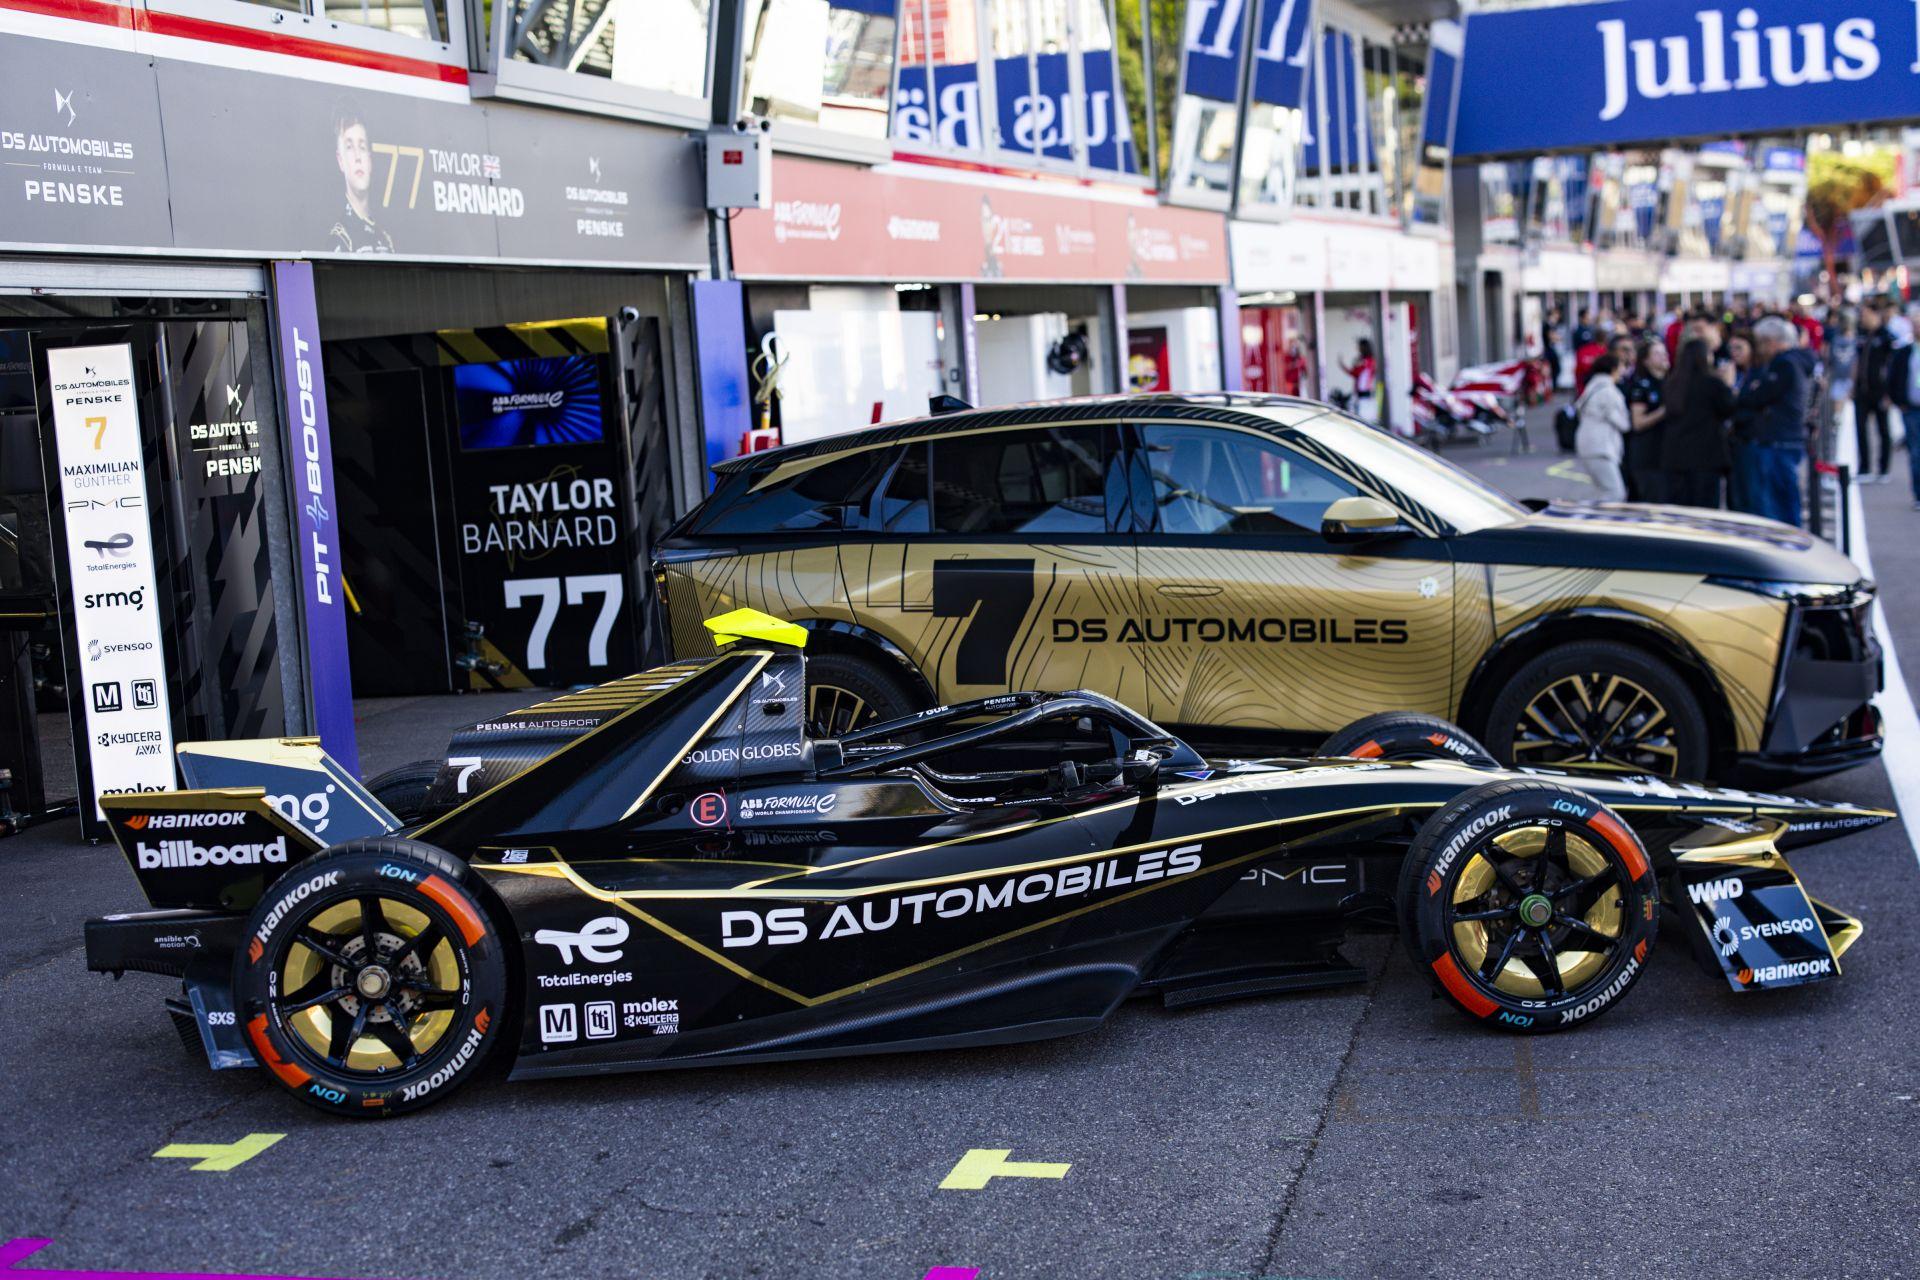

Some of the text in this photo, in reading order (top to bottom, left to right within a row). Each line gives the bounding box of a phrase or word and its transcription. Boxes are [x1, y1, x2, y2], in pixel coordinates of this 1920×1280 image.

[1597, 8, 1880, 121] Julius
[1, 131, 134, 160] DS AUTOMOBILES
[43, 162, 103, 175] FORMULA E TEAM
[429, 149, 482, 177] TAYLOR
[372, 143, 424, 209] 77
[25, 180, 124, 207] PENSKE
[433, 181, 525, 218] BARNARD
[577, 219, 624, 237] PENSKE
[69, 379, 129, 390] AUTOMOBILES
[66, 395, 122, 406] PENSKE
[85, 416, 107, 450] 7
[191, 425, 208, 439] DS
[64, 460, 139, 477] MAXIMILIAN
[293, 327, 332, 605] PIT BOOST
[68, 496, 142, 512] PMC
[489, 478, 616, 515] TAYLOR
[462, 515, 617, 554] BARNARD
[86, 562, 137, 572] TotalEnergies
[84, 586, 145, 611] srmg
[503, 573, 623, 671] 77
[933, 559, 1036, 686] 7
[1052, 618, 1409, 644] DS AUTOMOBILES
[103, 642, 153, 653] SYENSQO
[984, 696, 1016, 706] PENSKE
[476, 718, 601, 731] PENSKE AUTOSPORT
[742, 743, 801, 760] GLOBES
[448, 756, 482, 794] 7
[700, 797, 717, 821] E
[740, 799, 763, 810] ABB
[763, 795, 817, 810] FORMULA
[136, 834, 287, 870] billboard
[720, 843, 1203, 948] DS AUTOMOBILES
[1687, 877, 1743, 904] WWD
[154, 935, 182, 943] ansible
[1740, 917, 1814, 941] SYENSQO
[160, 941, 186, 949] motion
[537, 970, 633, 988] TotalEnergies
[623, 997, 678, 1014] molex
[208, 1012, 236, 1026] SXS
[544, 1008, 572, 1034] M
